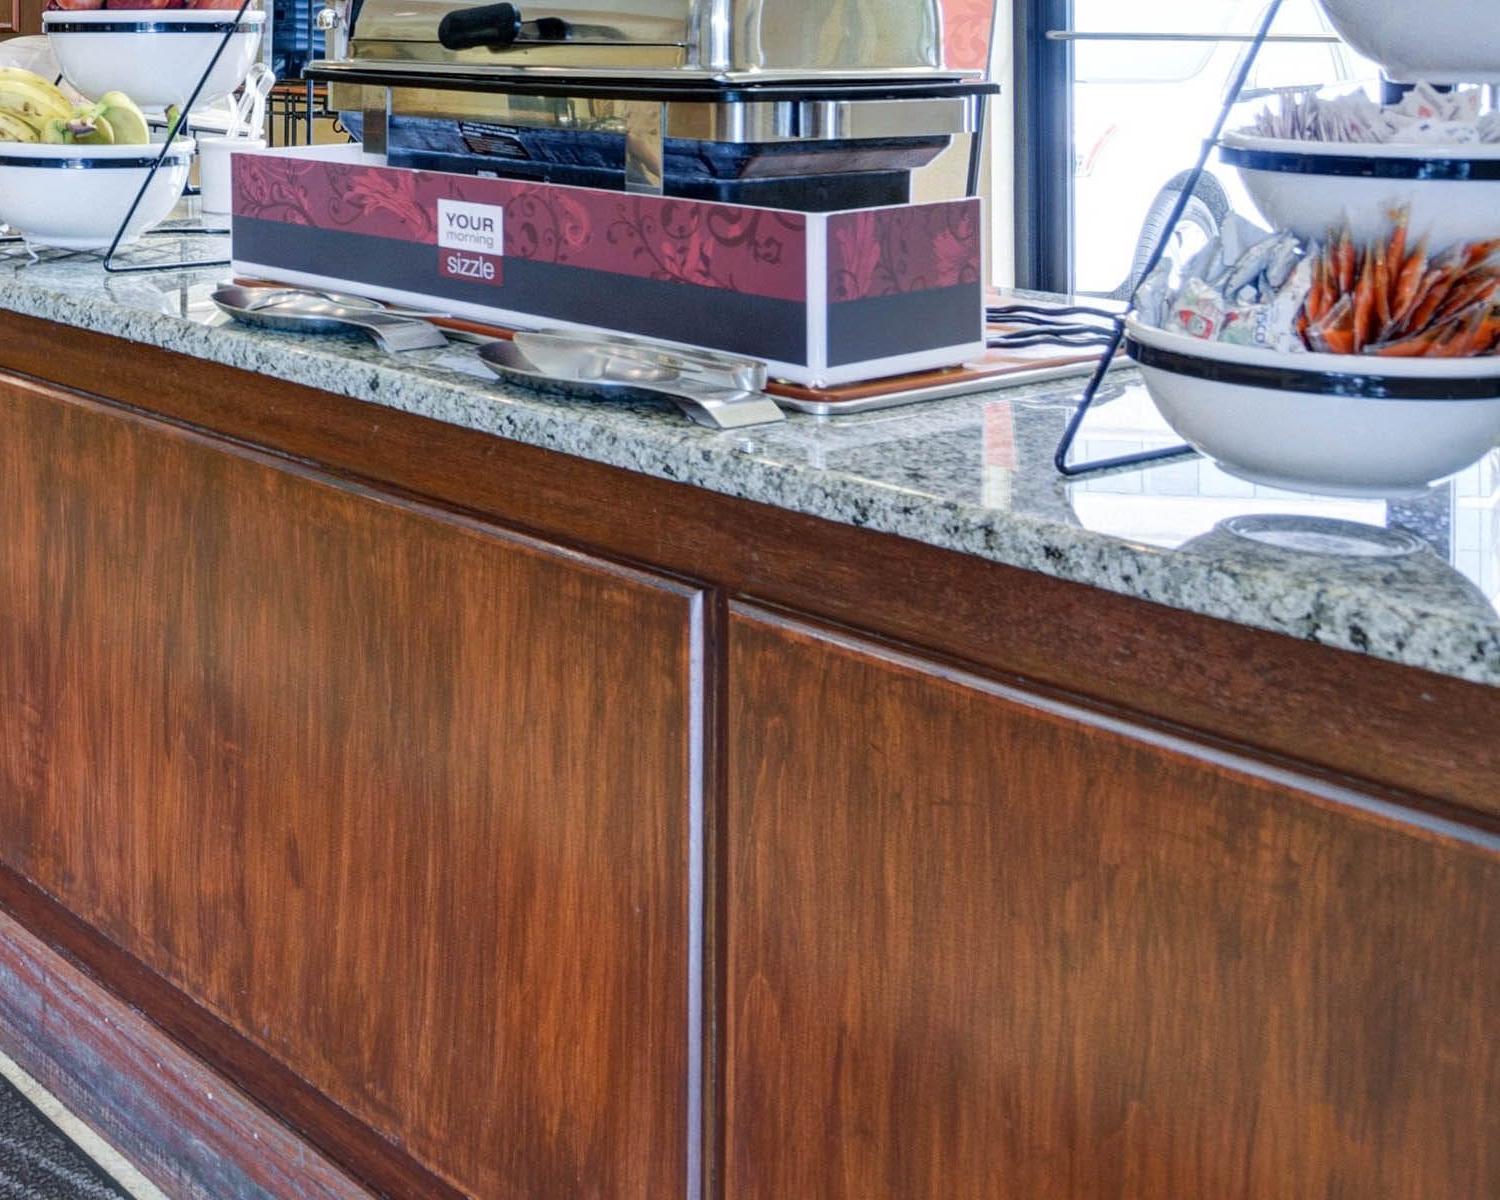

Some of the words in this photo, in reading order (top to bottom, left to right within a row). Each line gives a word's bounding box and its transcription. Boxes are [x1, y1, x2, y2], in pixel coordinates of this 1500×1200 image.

[446, 212, 494, 232] YOUR
[446, 231, 494, 249] morning
[447, 252, 495, 280] sizzle
